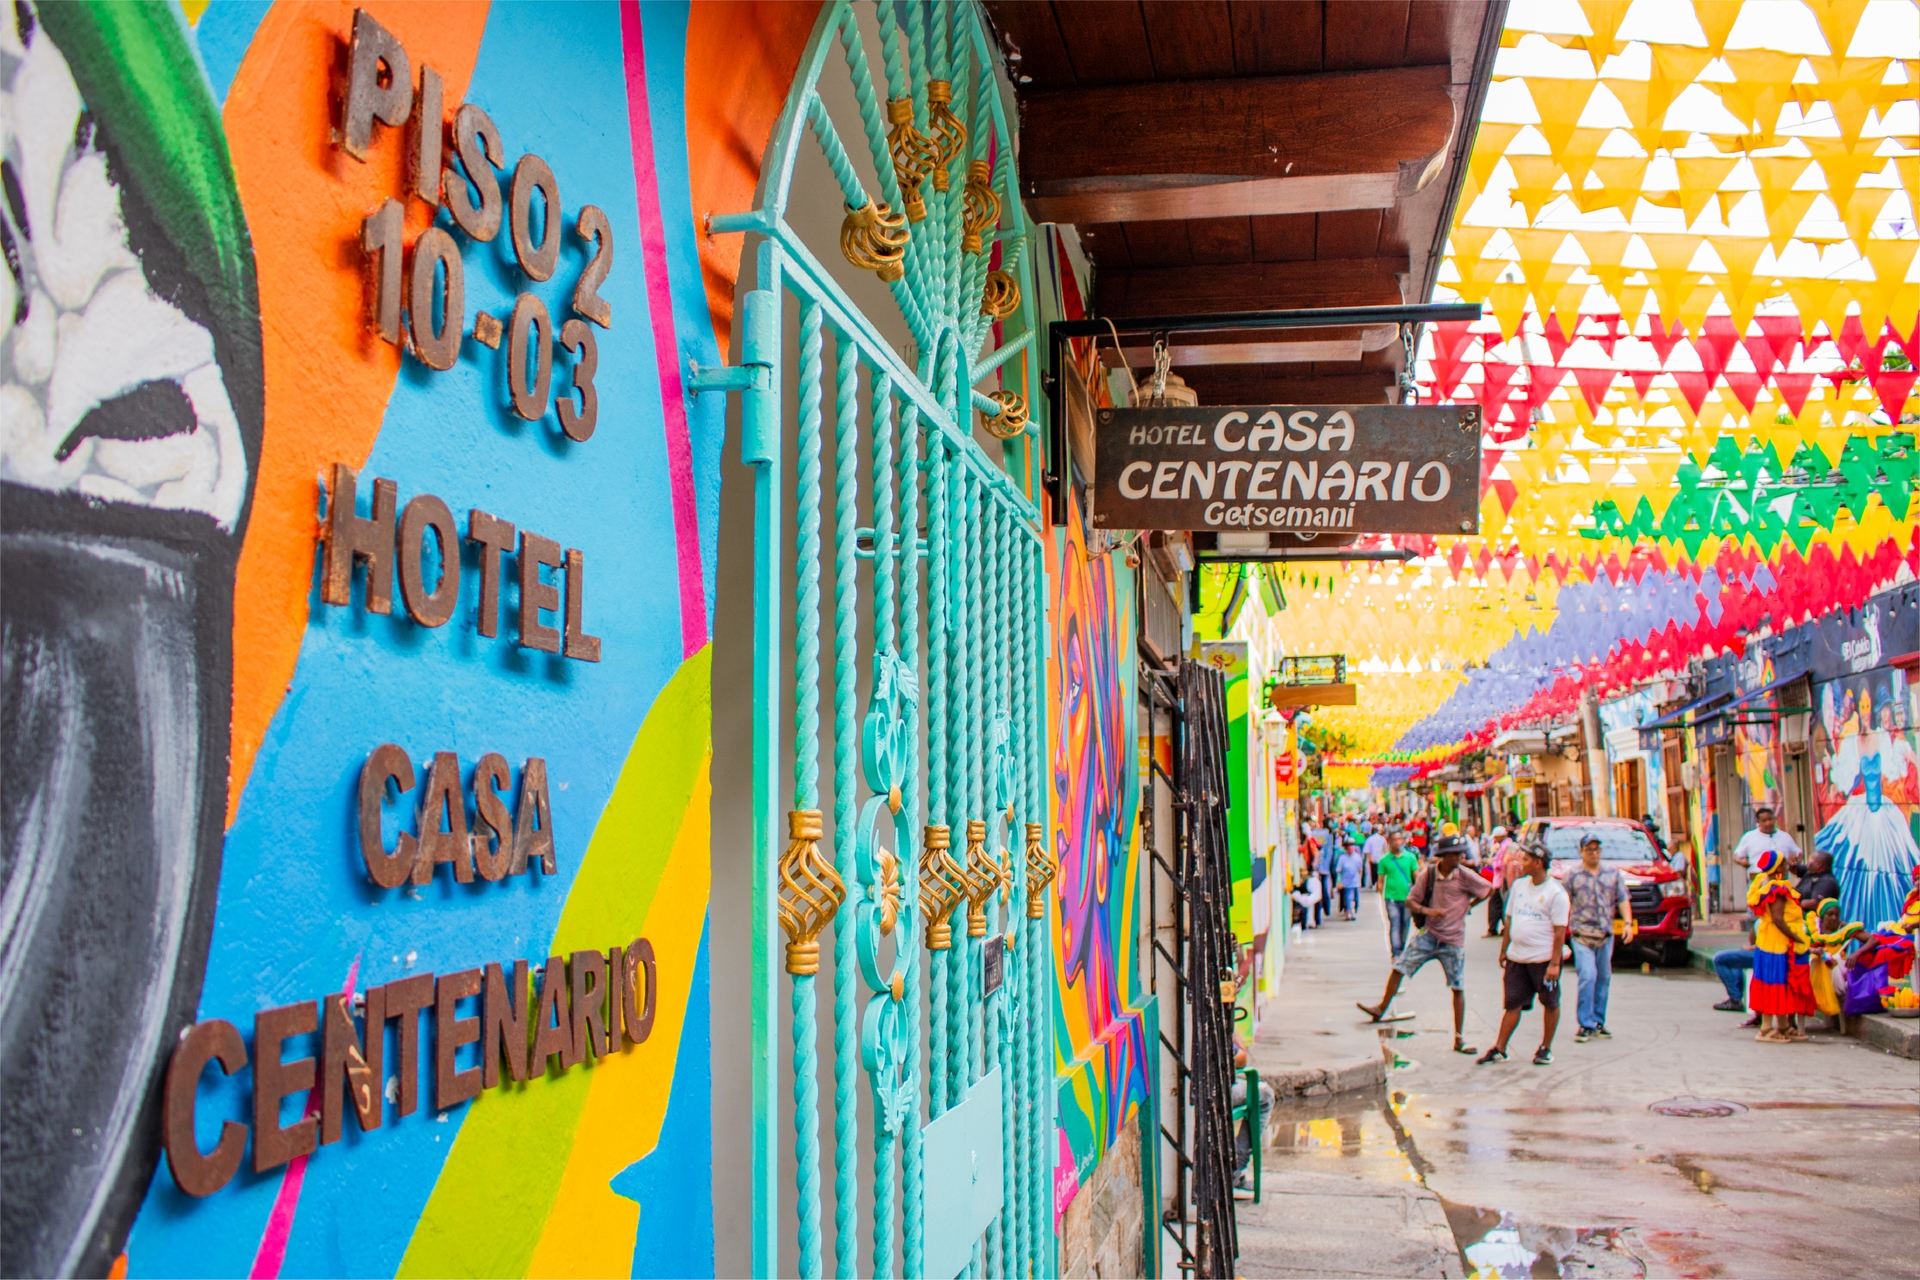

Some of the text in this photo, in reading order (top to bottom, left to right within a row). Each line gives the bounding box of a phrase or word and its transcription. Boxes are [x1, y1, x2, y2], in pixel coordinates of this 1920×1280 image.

[339, 7, 613, 329] PISO 2
[361, 196, 598, 442] 10-03
[1118, 460, 1451, 502] CENTENARIO
[1129, 410, 1355, 452] HOTEL CASA
[1204, 501, 1357, 528] Getsemani
[320, 462, 601, 662] HOTEL
[358, 743, 557, 889] CASA
[163, 937, 657, 1198] CENTENARIO
